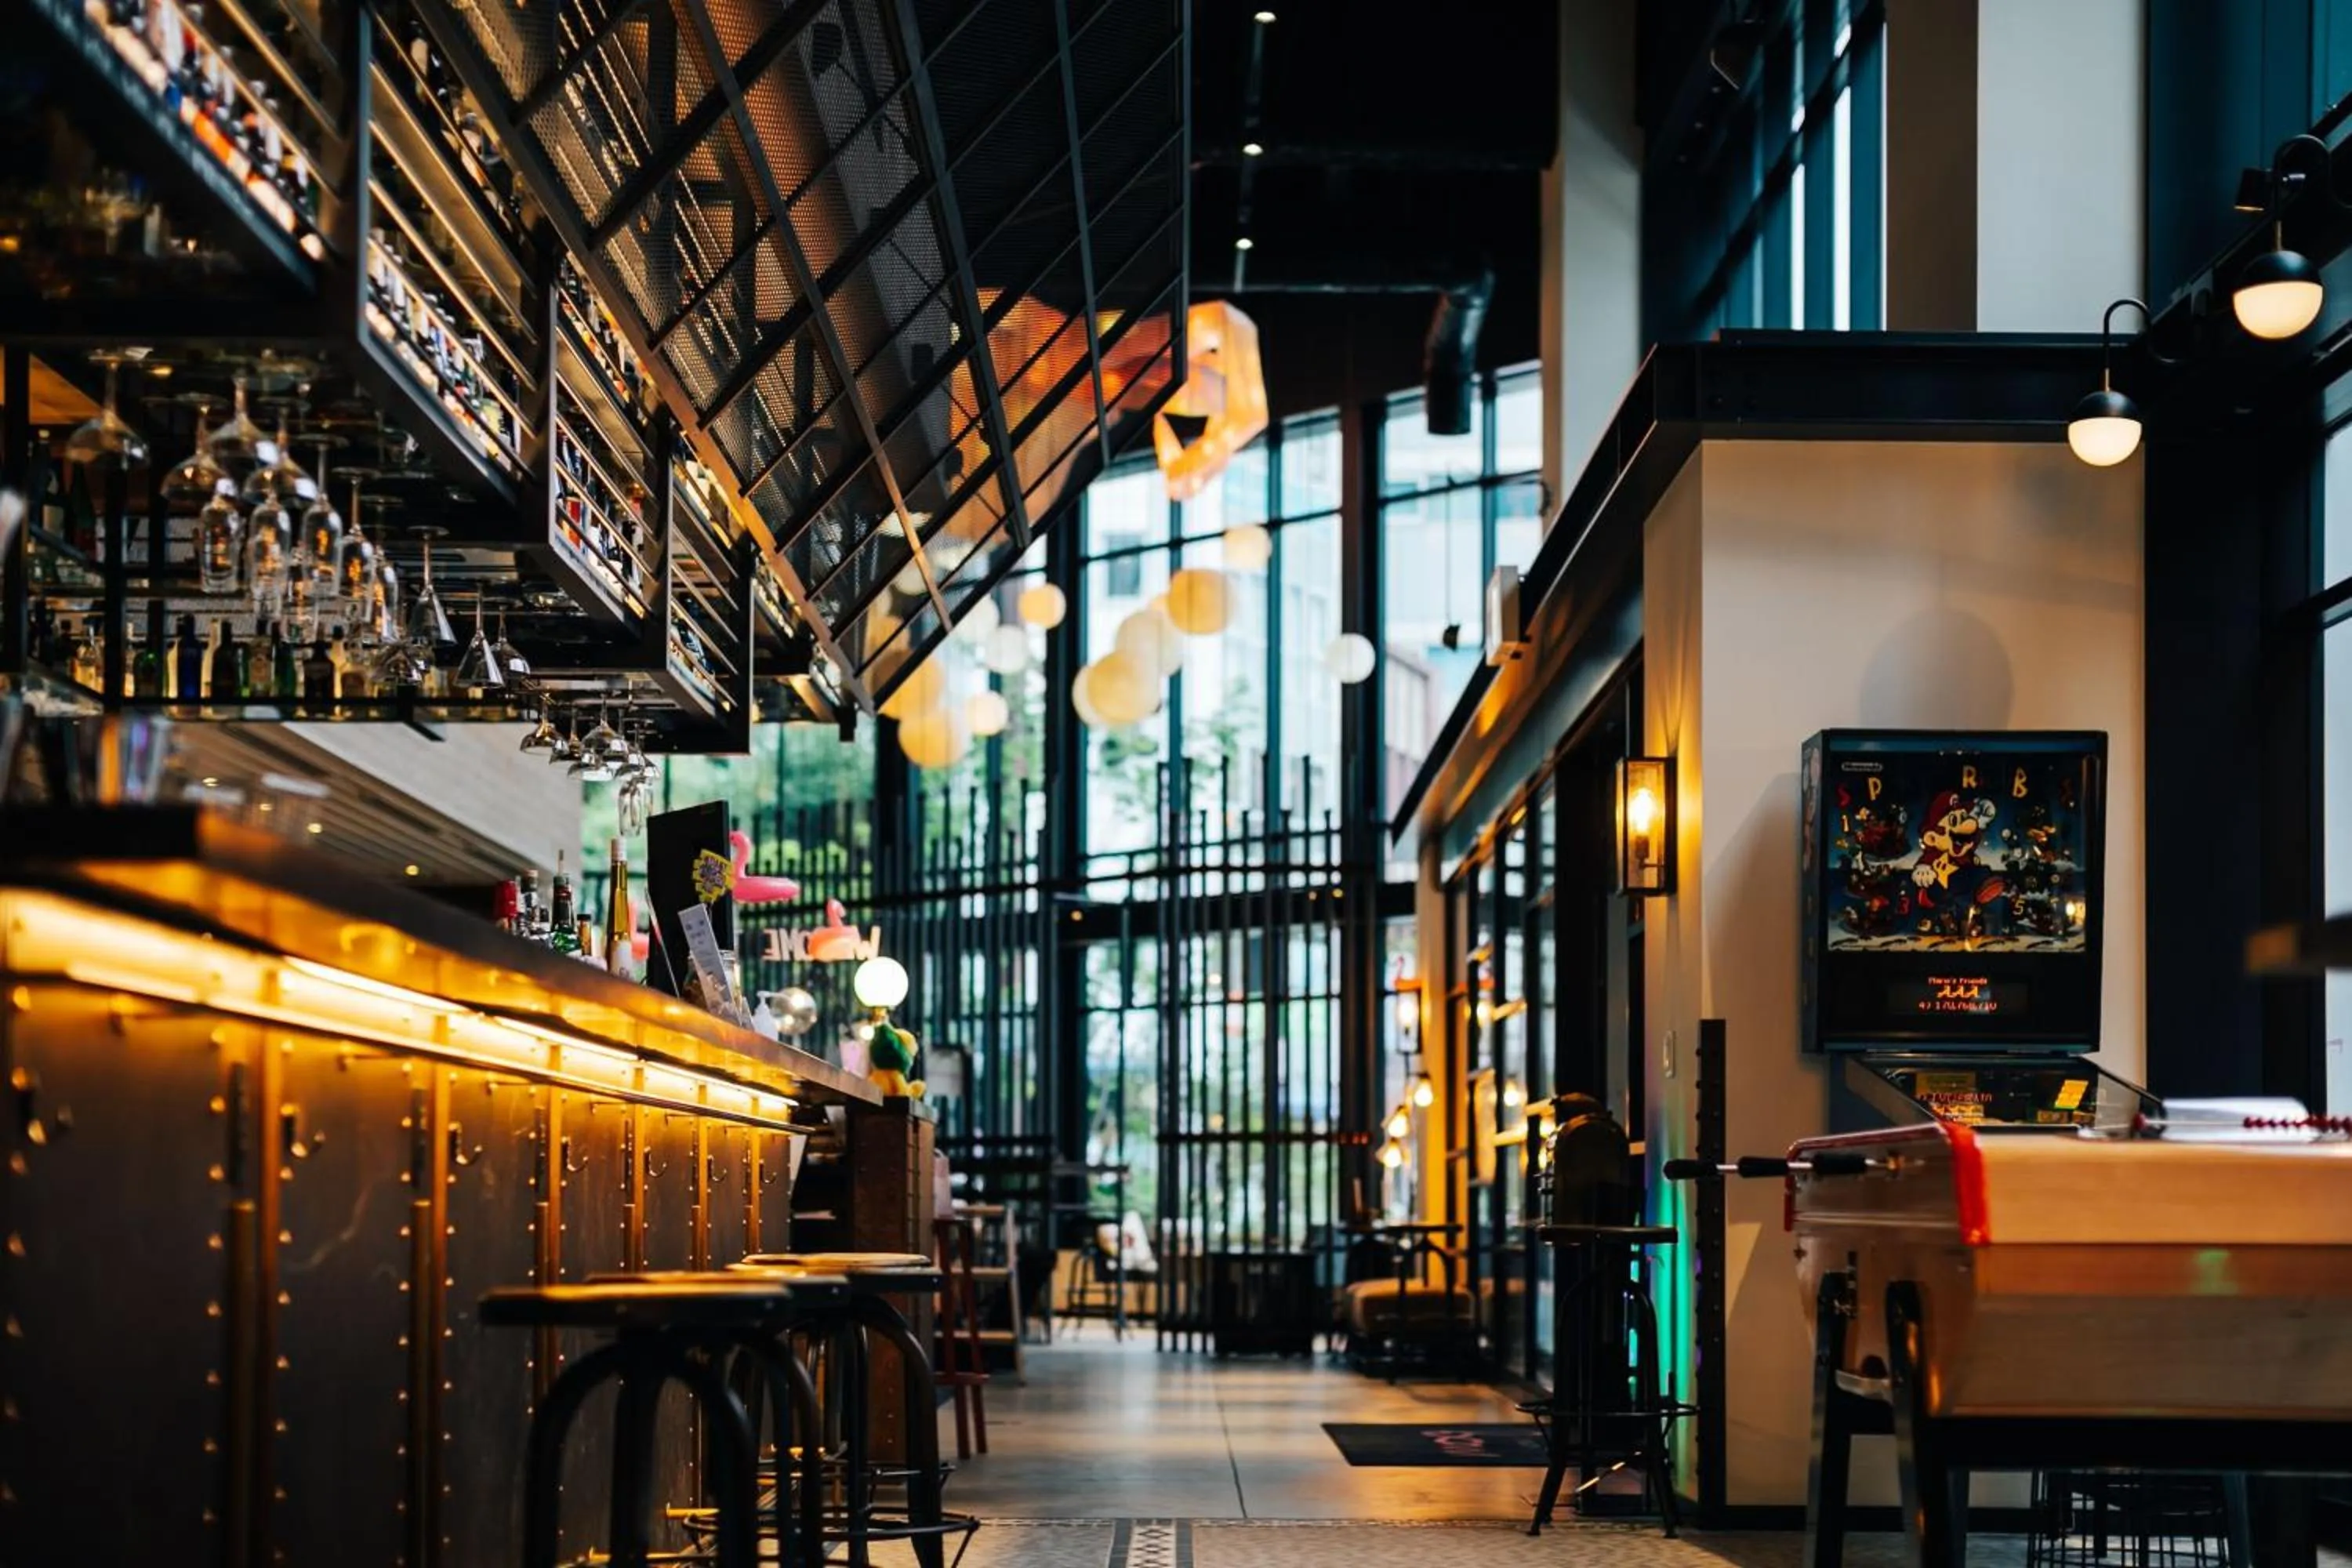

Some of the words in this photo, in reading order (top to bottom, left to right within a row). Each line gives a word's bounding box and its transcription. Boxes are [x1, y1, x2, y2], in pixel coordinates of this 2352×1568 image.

[1962, 764, 1979, 790] R
[2012, 766, 2029, 800] B
[1936, 985, 1982, 998] AAA
